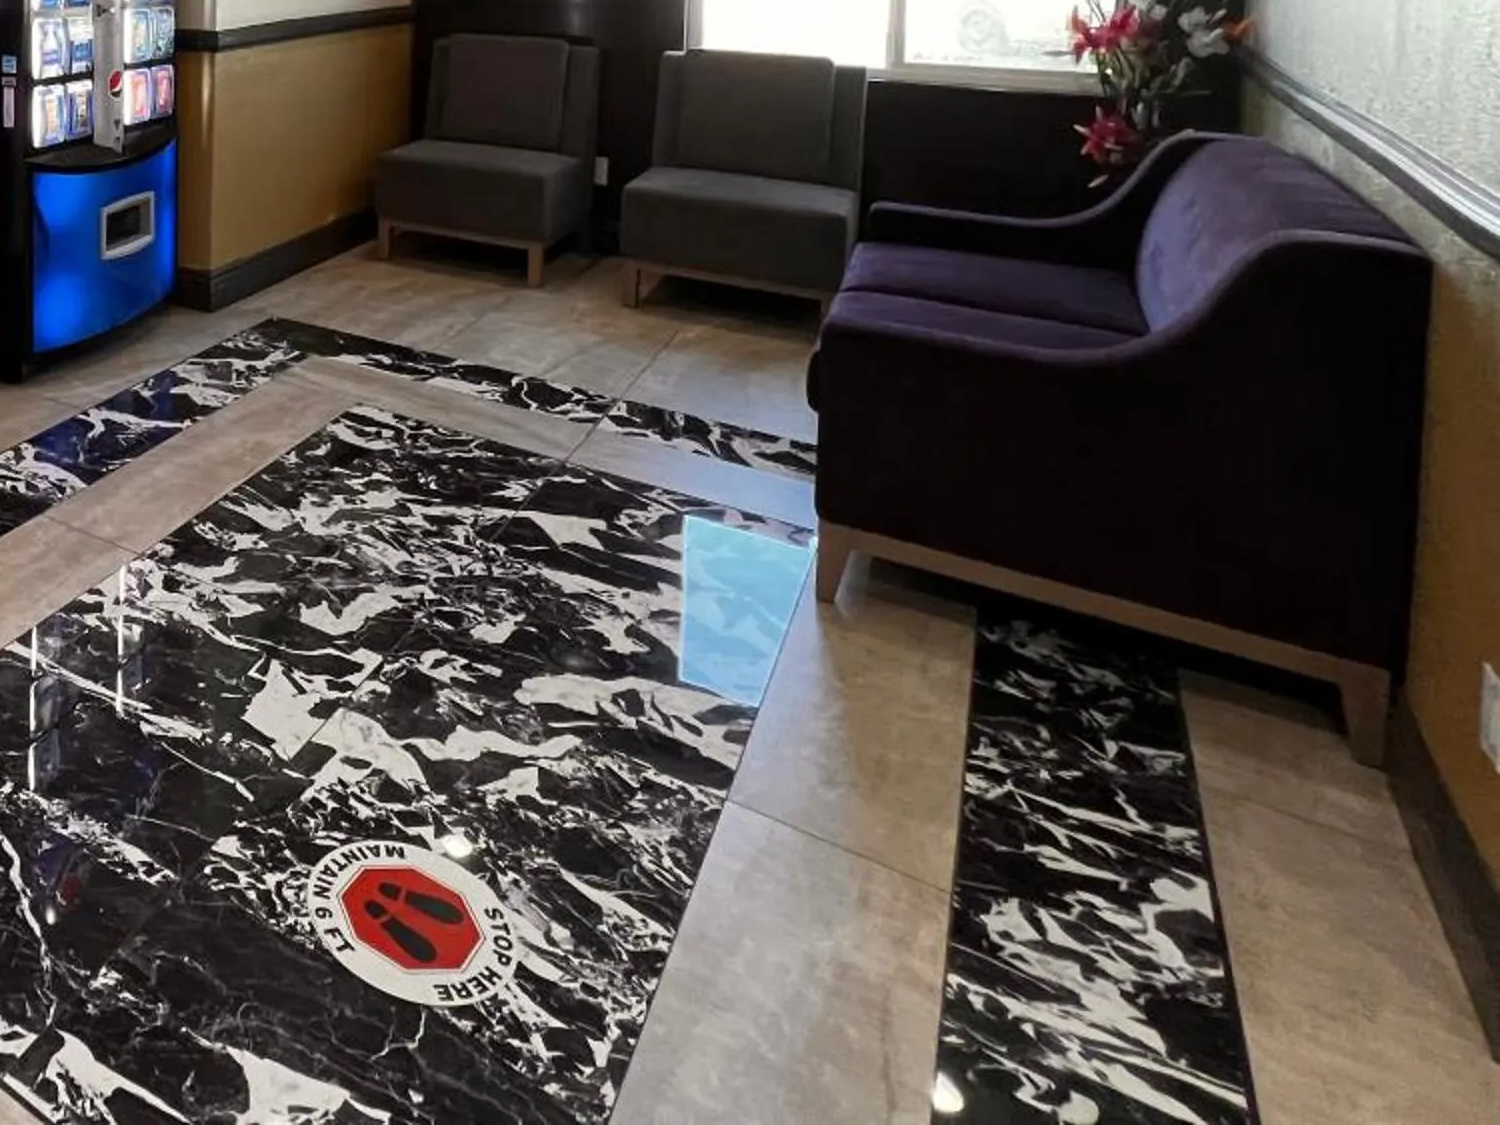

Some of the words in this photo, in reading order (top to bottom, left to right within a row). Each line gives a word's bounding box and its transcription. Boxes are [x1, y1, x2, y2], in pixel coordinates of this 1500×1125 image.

[312, 844, 406, 901] MAINTAIN
[314, 907, 333, 920] 6
[323, 926, 356, 954] FT
[483, 906, 514, 967] STOP
[433, 965, 504, 1003] HERE
